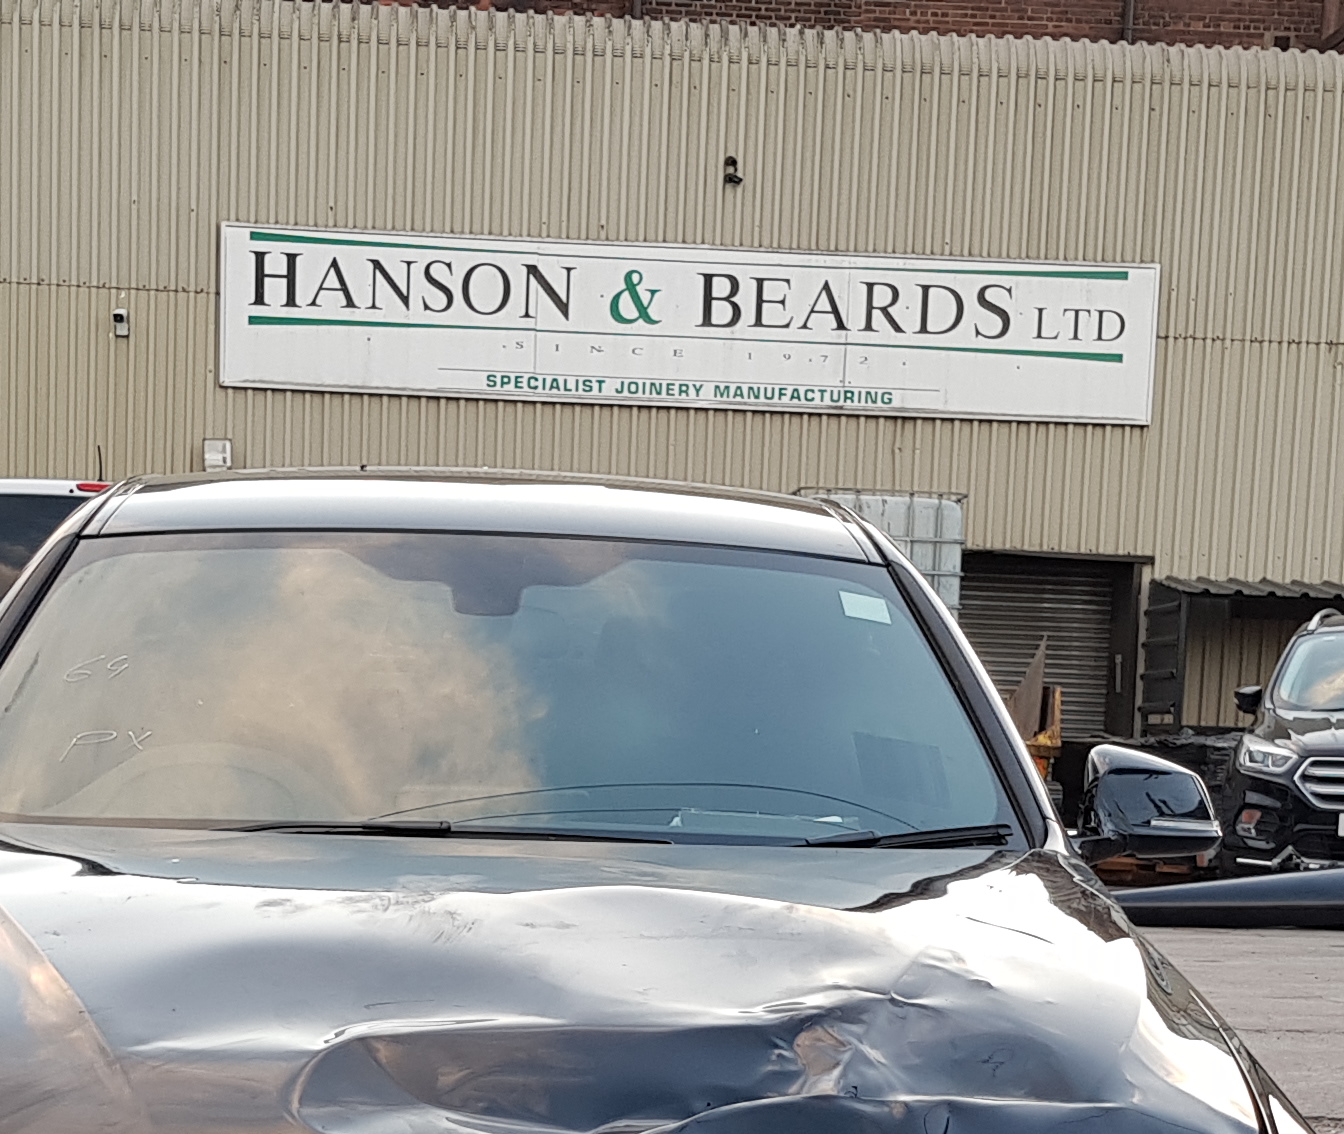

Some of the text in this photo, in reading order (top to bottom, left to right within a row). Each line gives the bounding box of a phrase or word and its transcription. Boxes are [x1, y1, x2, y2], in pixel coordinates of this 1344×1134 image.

[248, 250, 1126, 342] HANSON & BEARDS LTD
[486, 374, 894, 406] SPECIALIST JOINERY MANUFACTURING
